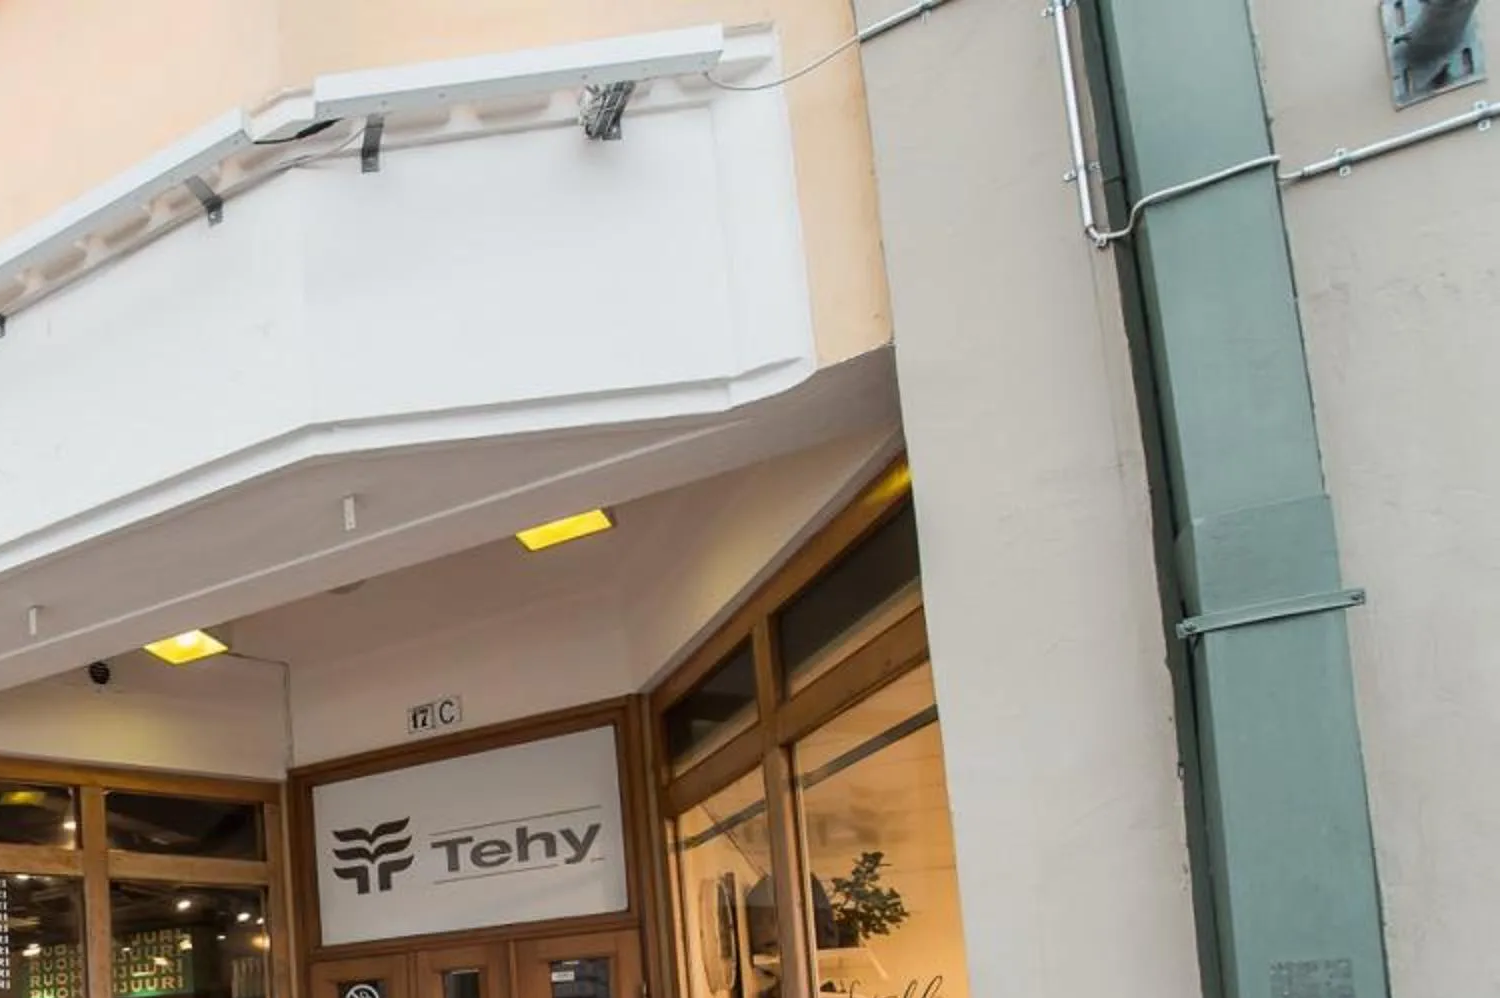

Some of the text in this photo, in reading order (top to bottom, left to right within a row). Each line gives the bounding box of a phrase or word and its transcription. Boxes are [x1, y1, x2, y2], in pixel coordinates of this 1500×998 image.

[412, 700, 455, 729] 17 C
[430, 823, 602, 873] Tehy
